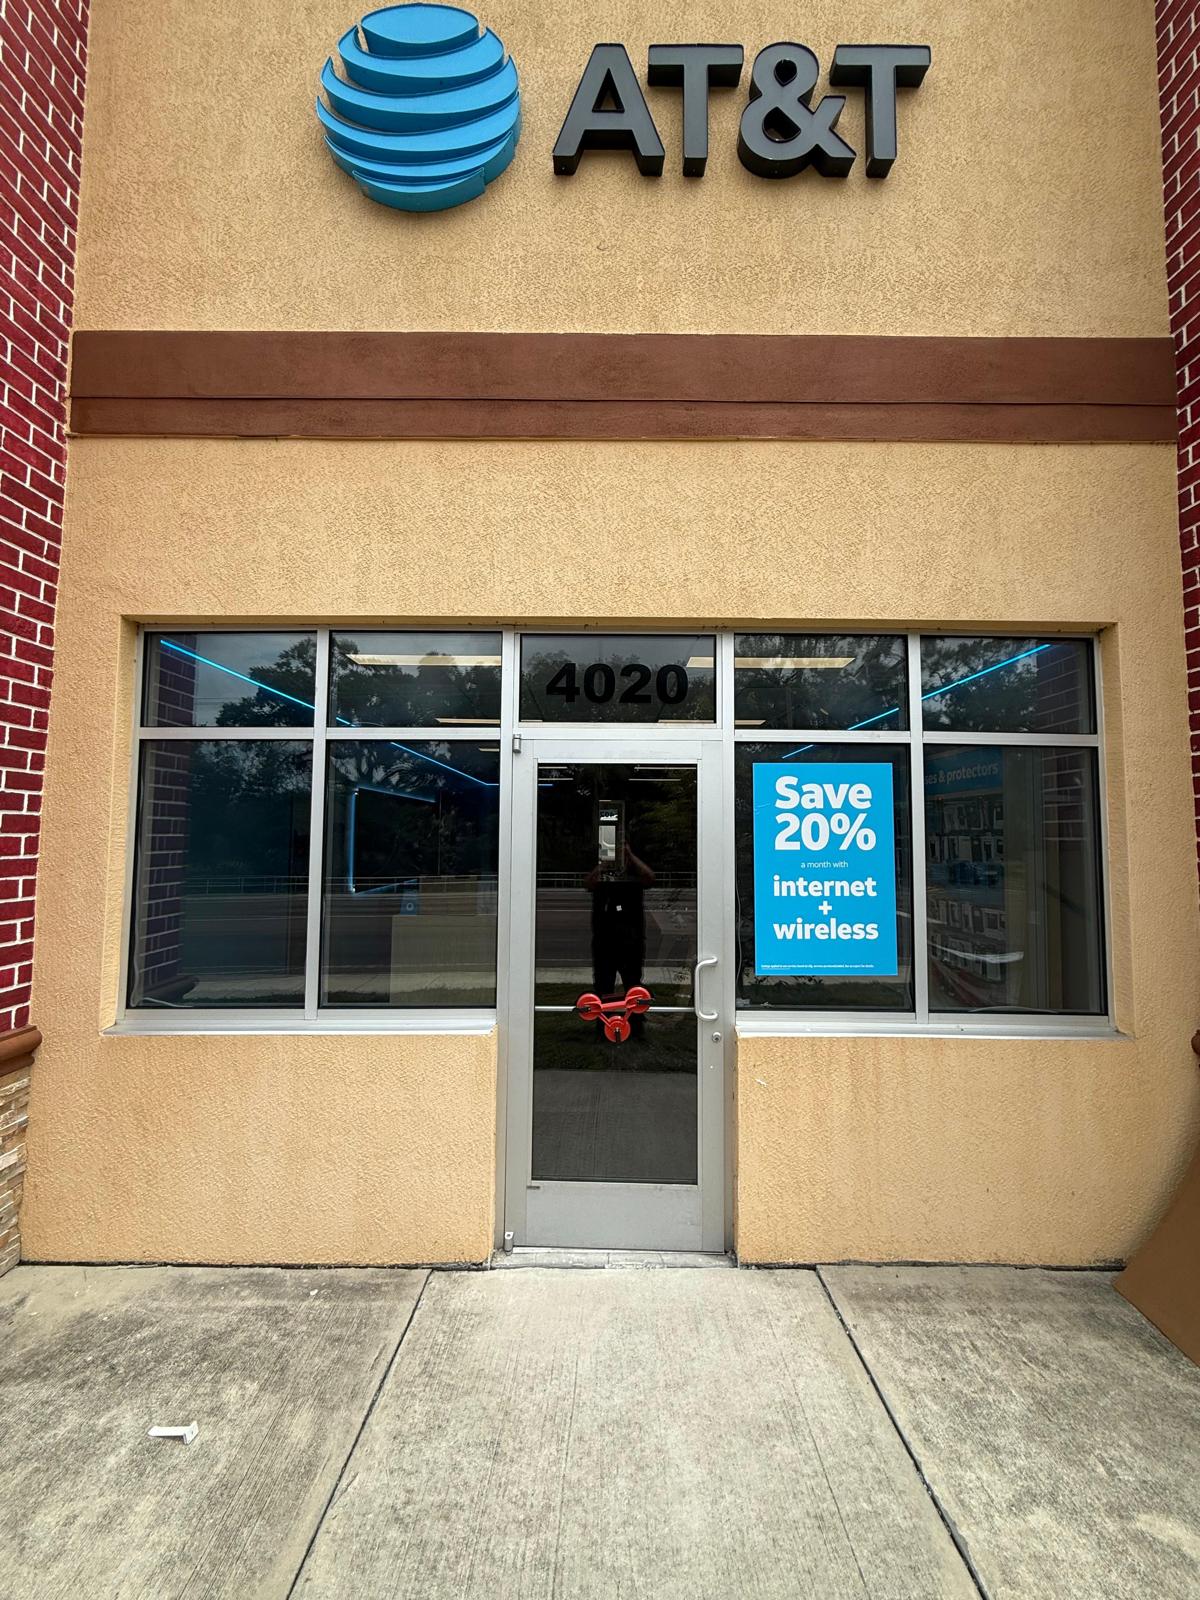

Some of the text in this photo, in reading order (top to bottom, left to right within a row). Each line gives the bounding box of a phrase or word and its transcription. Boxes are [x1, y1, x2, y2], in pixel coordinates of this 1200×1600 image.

[552, 41, 932, 179] AT&T
[546, 662, 689, 704] 4020
[938, 770, 946, 783] &
[946, 762, 998, 784] protectors
[774, 775, 872, 810] Save
[774, 812, 877, 851] 20%
[807, 860, 831, 868] month
[832, 860, 849, 868] with
[773, 874, 877, 897] internet
[818, 900, 833, 915] +
[773, 917, 879, 940] wireless
